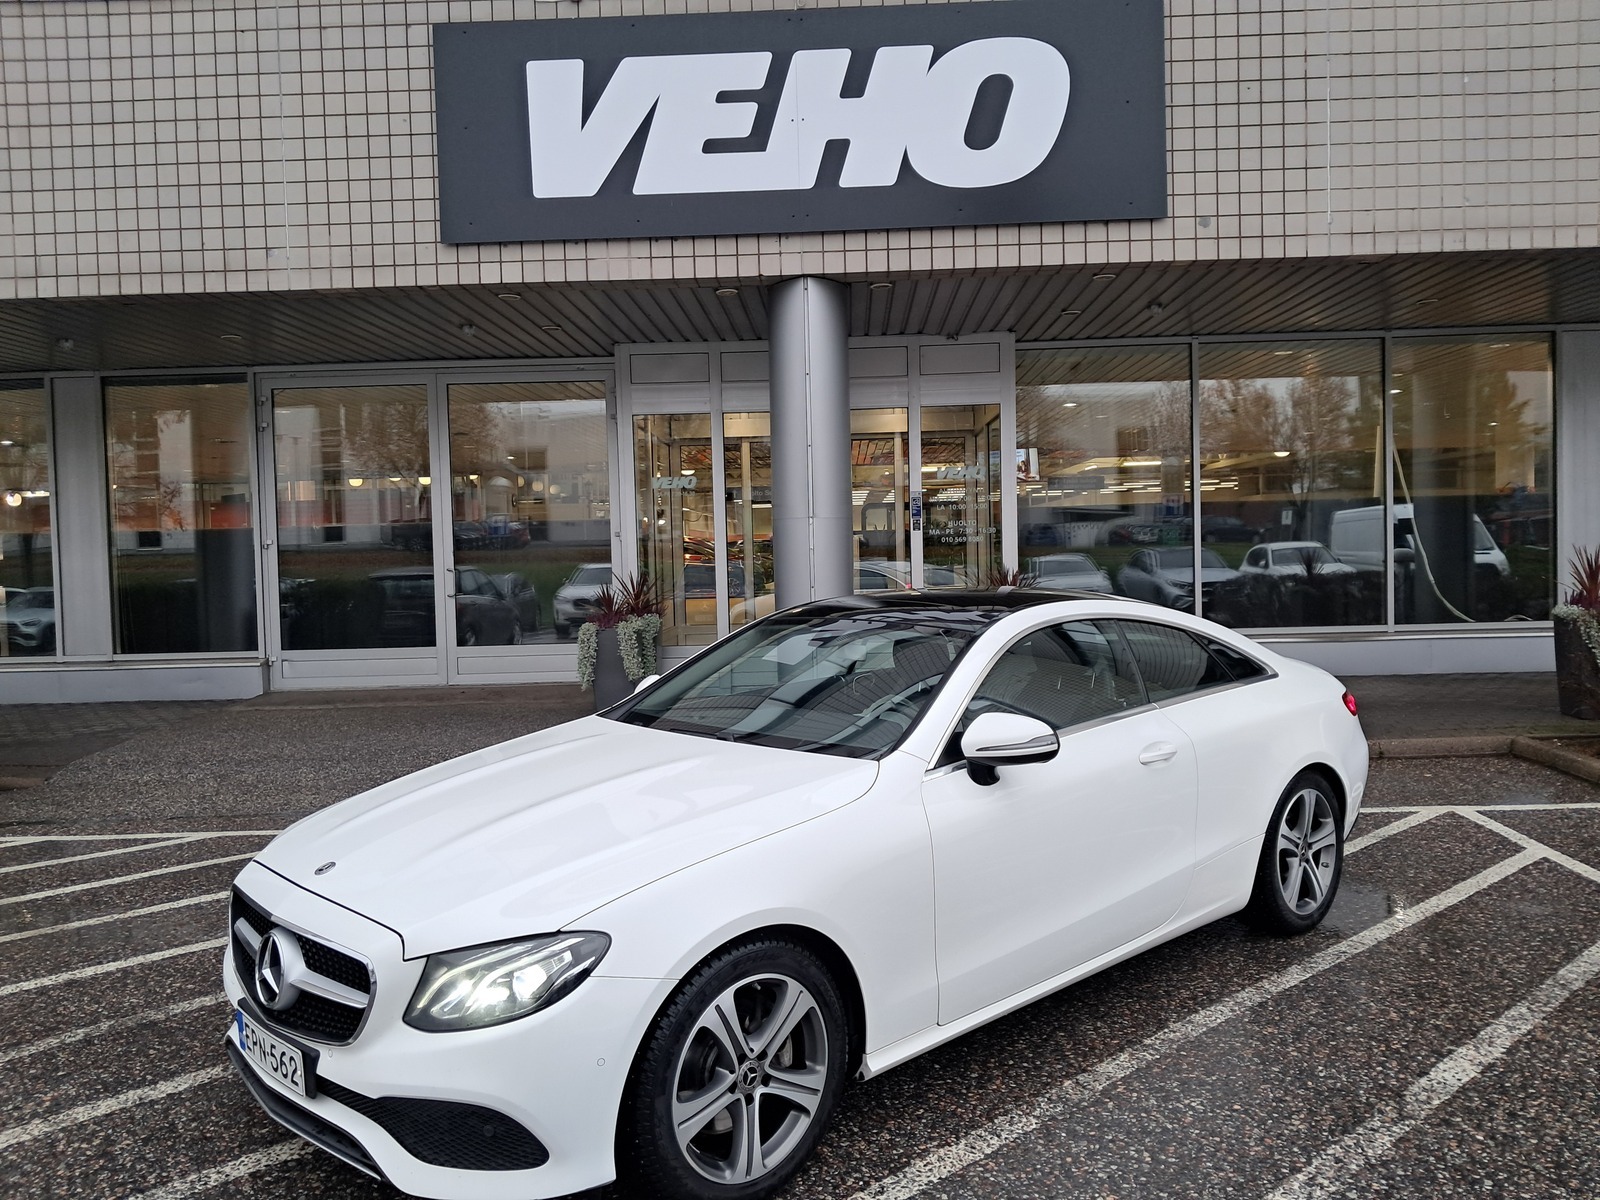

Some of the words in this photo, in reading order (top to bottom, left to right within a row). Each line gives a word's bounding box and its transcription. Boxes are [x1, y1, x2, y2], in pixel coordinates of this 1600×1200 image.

[525, 37, 1071, 198] VEHO
[652, 475, 697, 489] VEHO
[937, 466, 986, 481] VEHO
[244, 1021, 299, 1087] EPN-562
